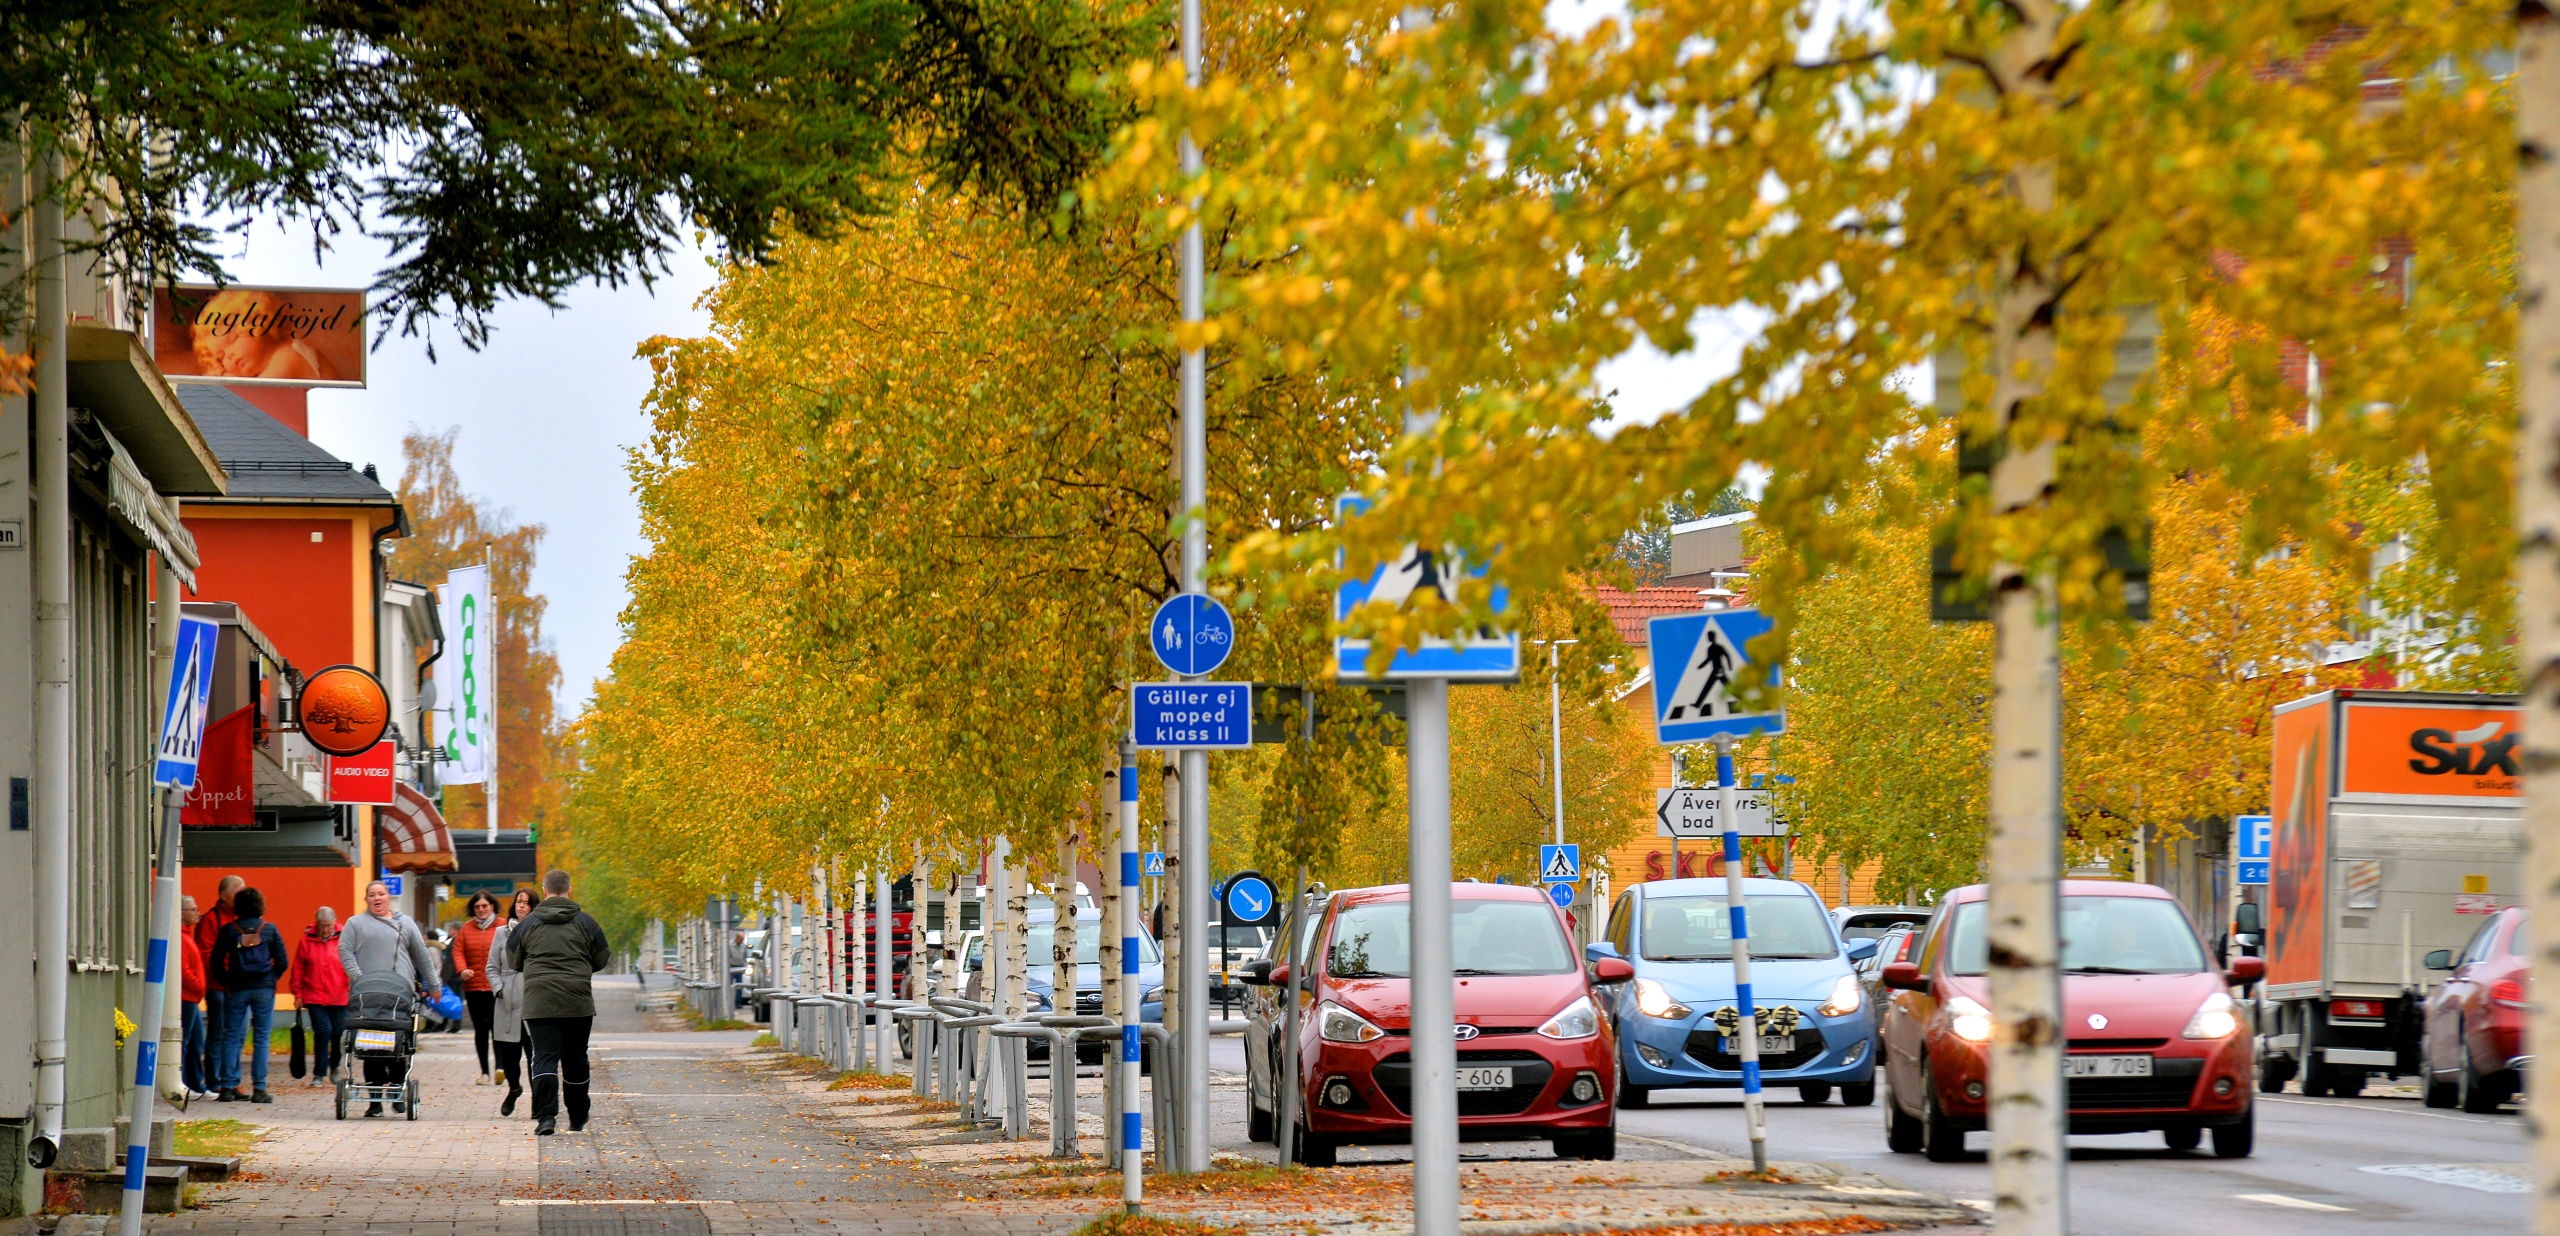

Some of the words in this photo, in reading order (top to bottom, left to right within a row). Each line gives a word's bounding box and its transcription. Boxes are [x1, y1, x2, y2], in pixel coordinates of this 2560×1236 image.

[1148, 690, 1209, 705] Gäller
[1217, 689, 1235, 708] ej
[1160, 708, 1225, 726] moped
[1156, 726, 1209, 741] klass
[333, 767, 362, 776] AUDIO
[363, 767, 390, 777] VIDEO
[1682, 815, 1714, 828] bad
[2246, 867, 2256, 878] 2
[2110, 1058, 2148, 1074] 709
[1470, 1069, 1505, 1085] 606
